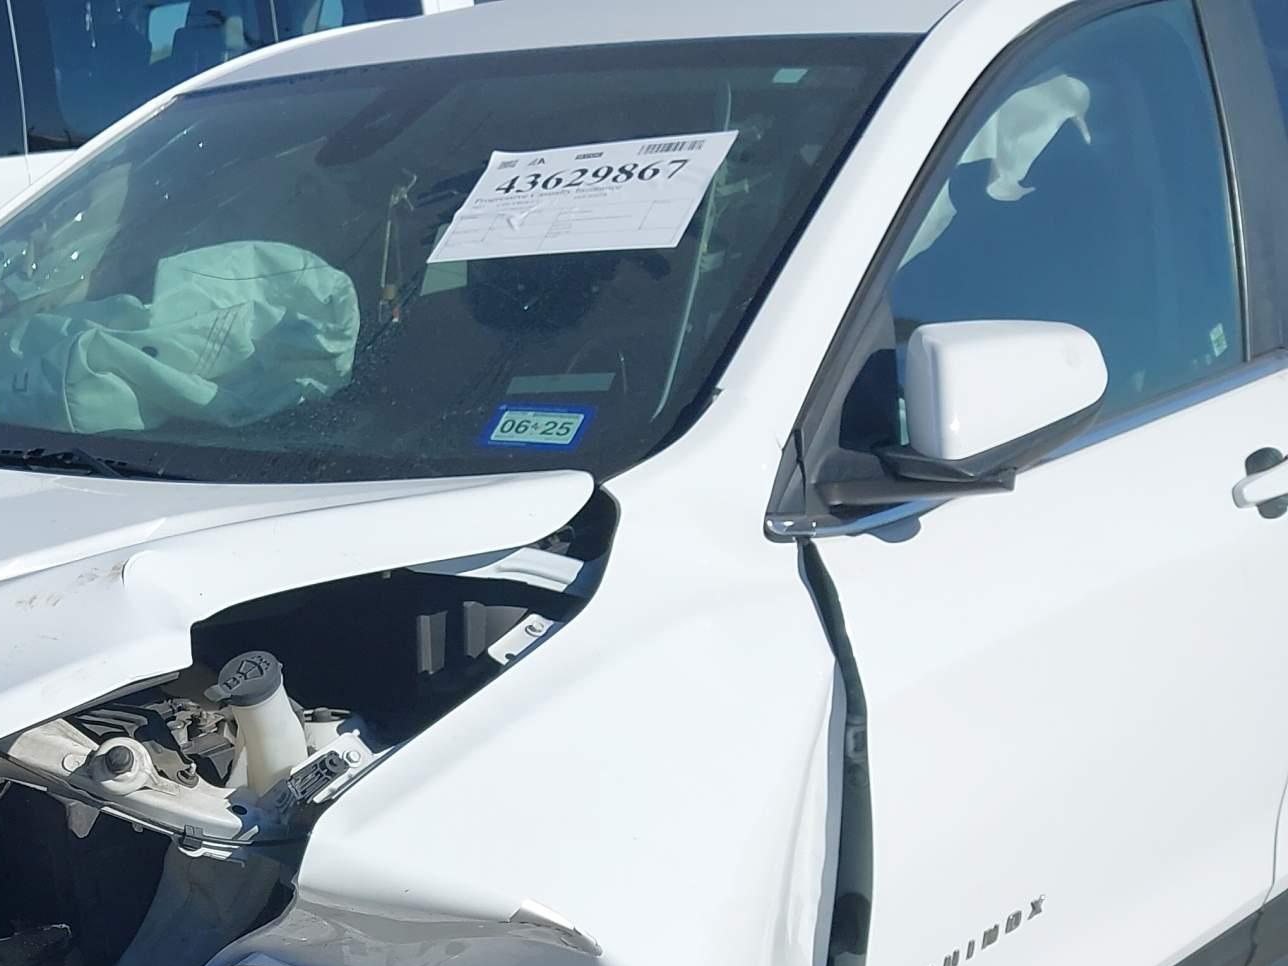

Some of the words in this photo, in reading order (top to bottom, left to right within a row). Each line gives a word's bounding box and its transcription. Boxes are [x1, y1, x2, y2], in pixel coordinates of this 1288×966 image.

[496, 159, 691, 194] 43629867
[500, 419, 529, 434] 06
[540, 420, 573, 437] 25
